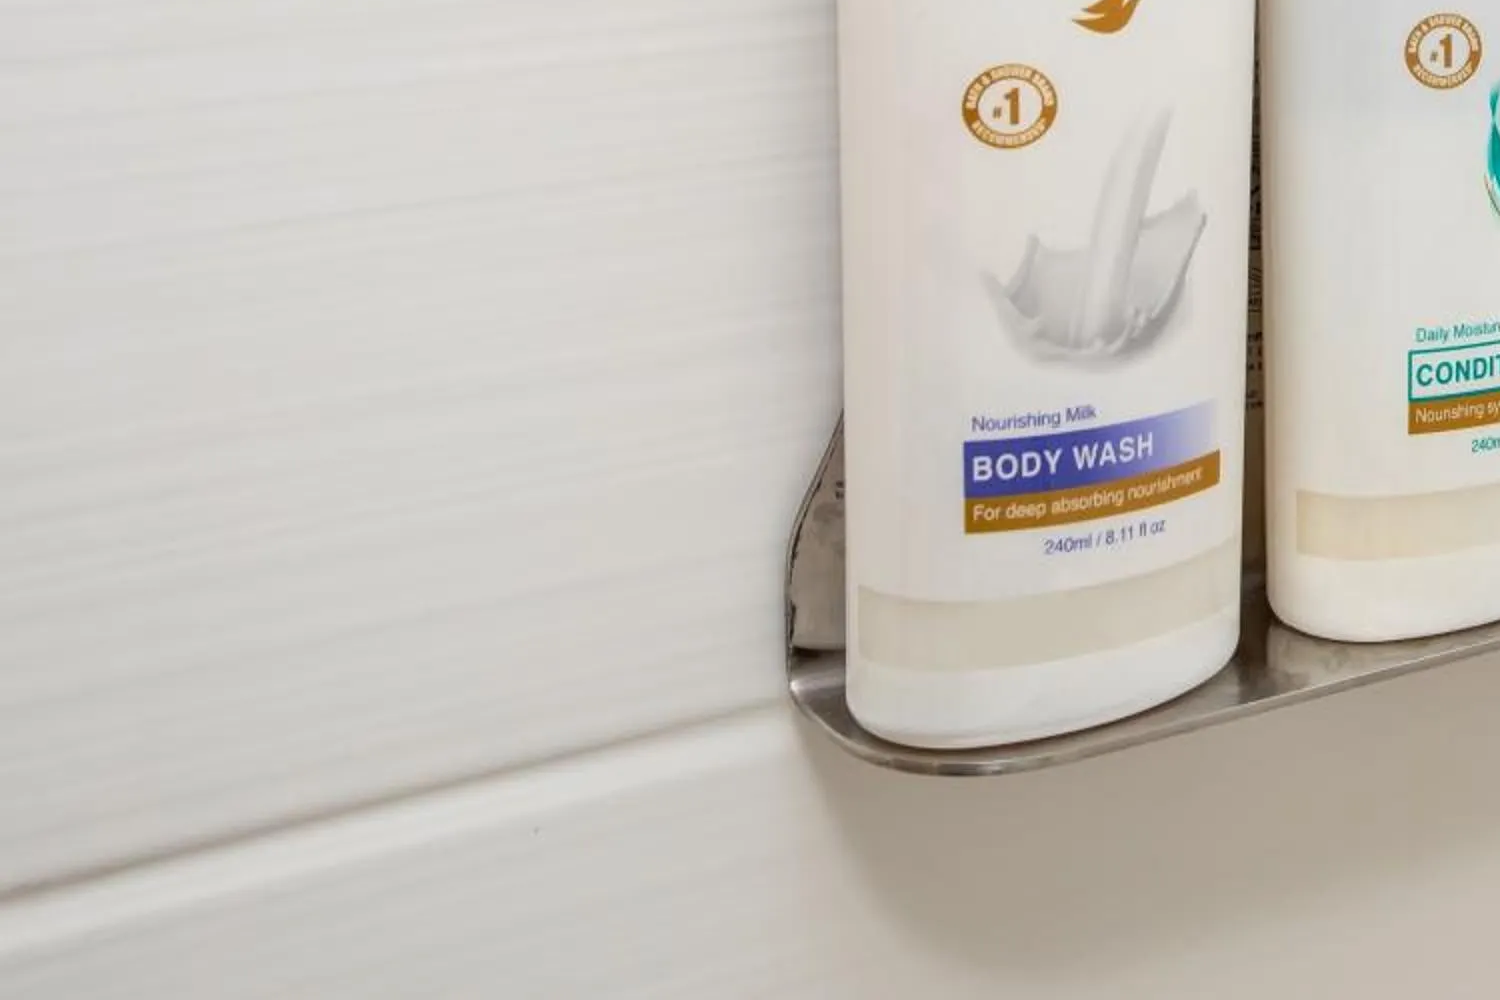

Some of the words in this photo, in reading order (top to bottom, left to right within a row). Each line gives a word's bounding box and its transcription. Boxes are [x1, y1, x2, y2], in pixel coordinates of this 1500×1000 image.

[1415, 325, 1450, 344] Daily
[971, 410, 1061, 433] Nourishing
[1065, 403, 1097, 422] Milk
[1415, 400, 1485, 424] Nourishing
[972, 448, 1063, 482] BODY
[1073, 431, 1153, 471] WASH
[973, 503, 1001, 523] For
[1005, 500, 1047, 520] deep
[1051, 488, 1125, 514] absorbing
[1128, 466, 1203, 500] nourishment
[1043, 531, 1093, 555] 240ml
[1105, 525, 1134, 546] 8.11
[1150, 519, 1166, 535] oz
